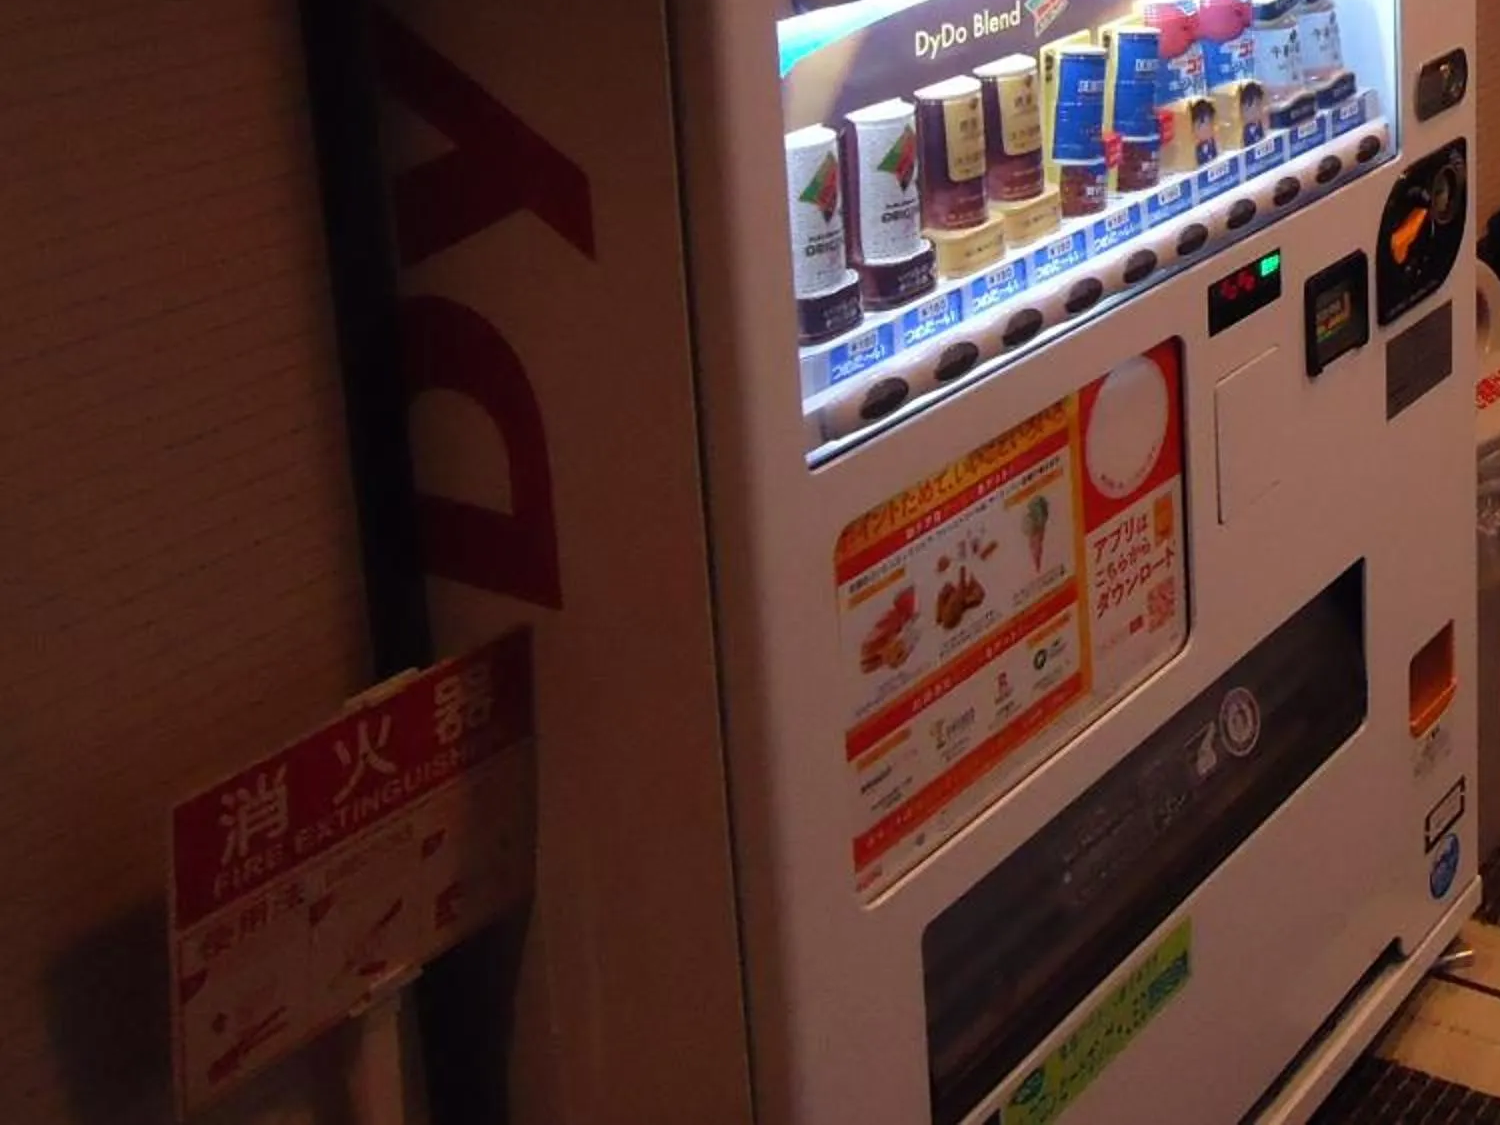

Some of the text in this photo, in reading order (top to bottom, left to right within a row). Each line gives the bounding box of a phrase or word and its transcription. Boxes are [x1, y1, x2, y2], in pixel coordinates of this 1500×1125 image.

[915, 0, 1021, 59] DyDo Blend
[212, 842, 286, 903] FIRE
[295, 745, 477, 857] EXTINGUISH
[218, 662, 496, 869] 消火器
